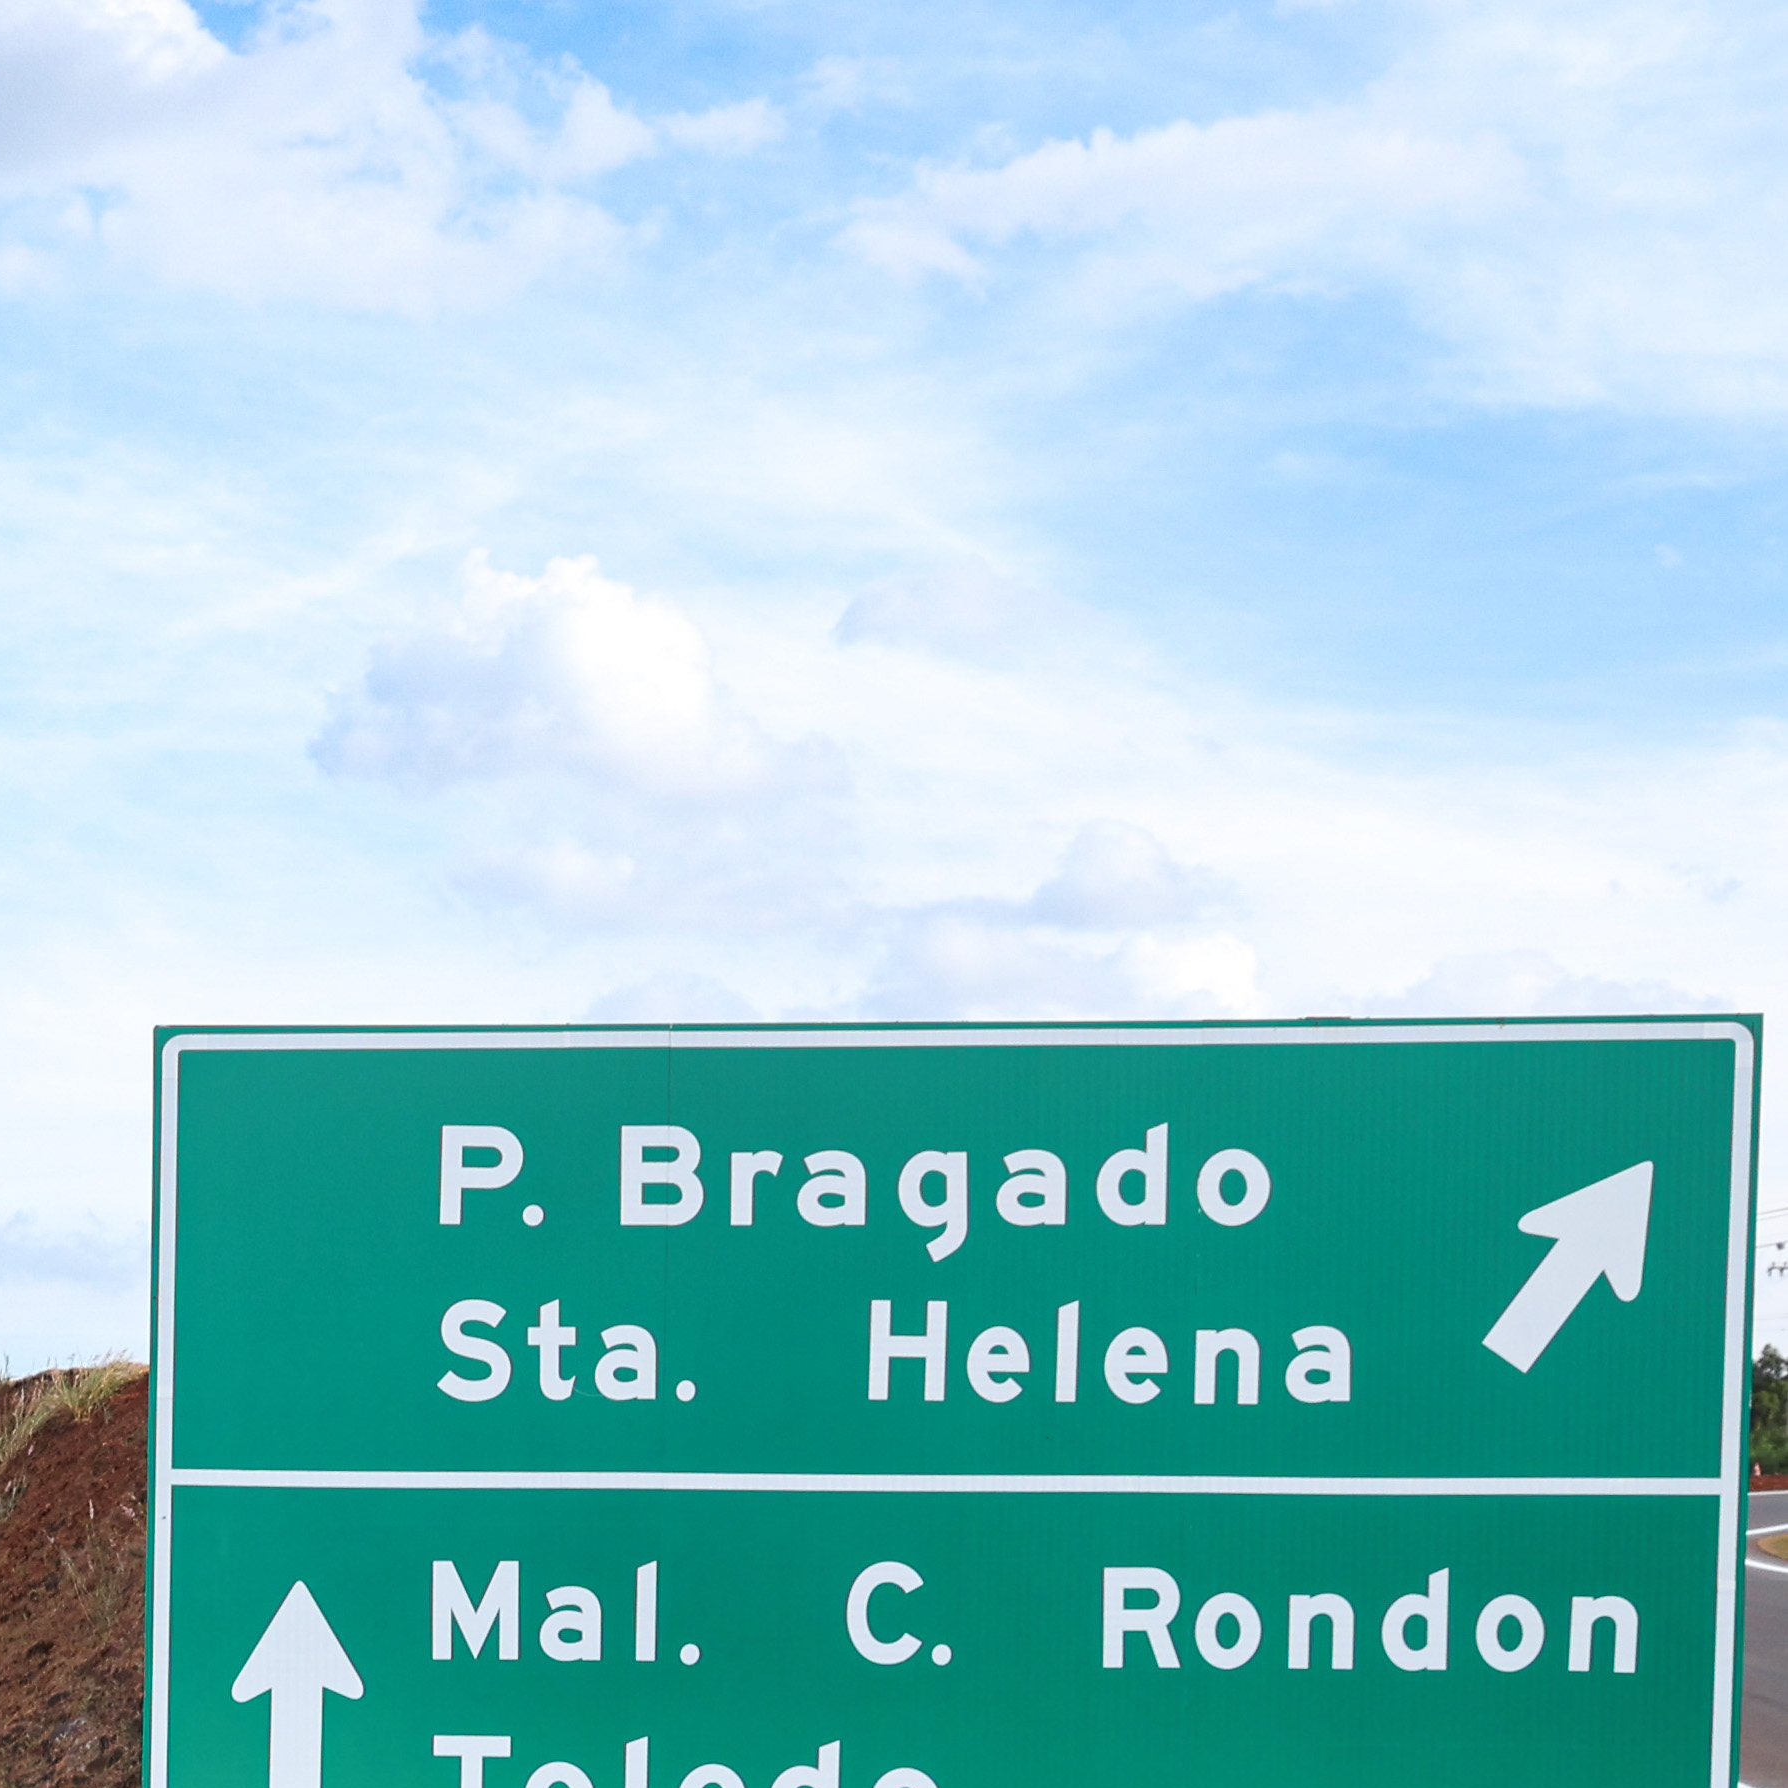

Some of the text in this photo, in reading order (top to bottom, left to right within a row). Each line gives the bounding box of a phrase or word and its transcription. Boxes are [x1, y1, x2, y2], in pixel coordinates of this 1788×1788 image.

[439, 1122, 1272, 1263] P. Bragado
[436, 1299, 1352, 1405] Sta. Helena
[432, 1560, 1639, 1674] Mal. C. Rondon
